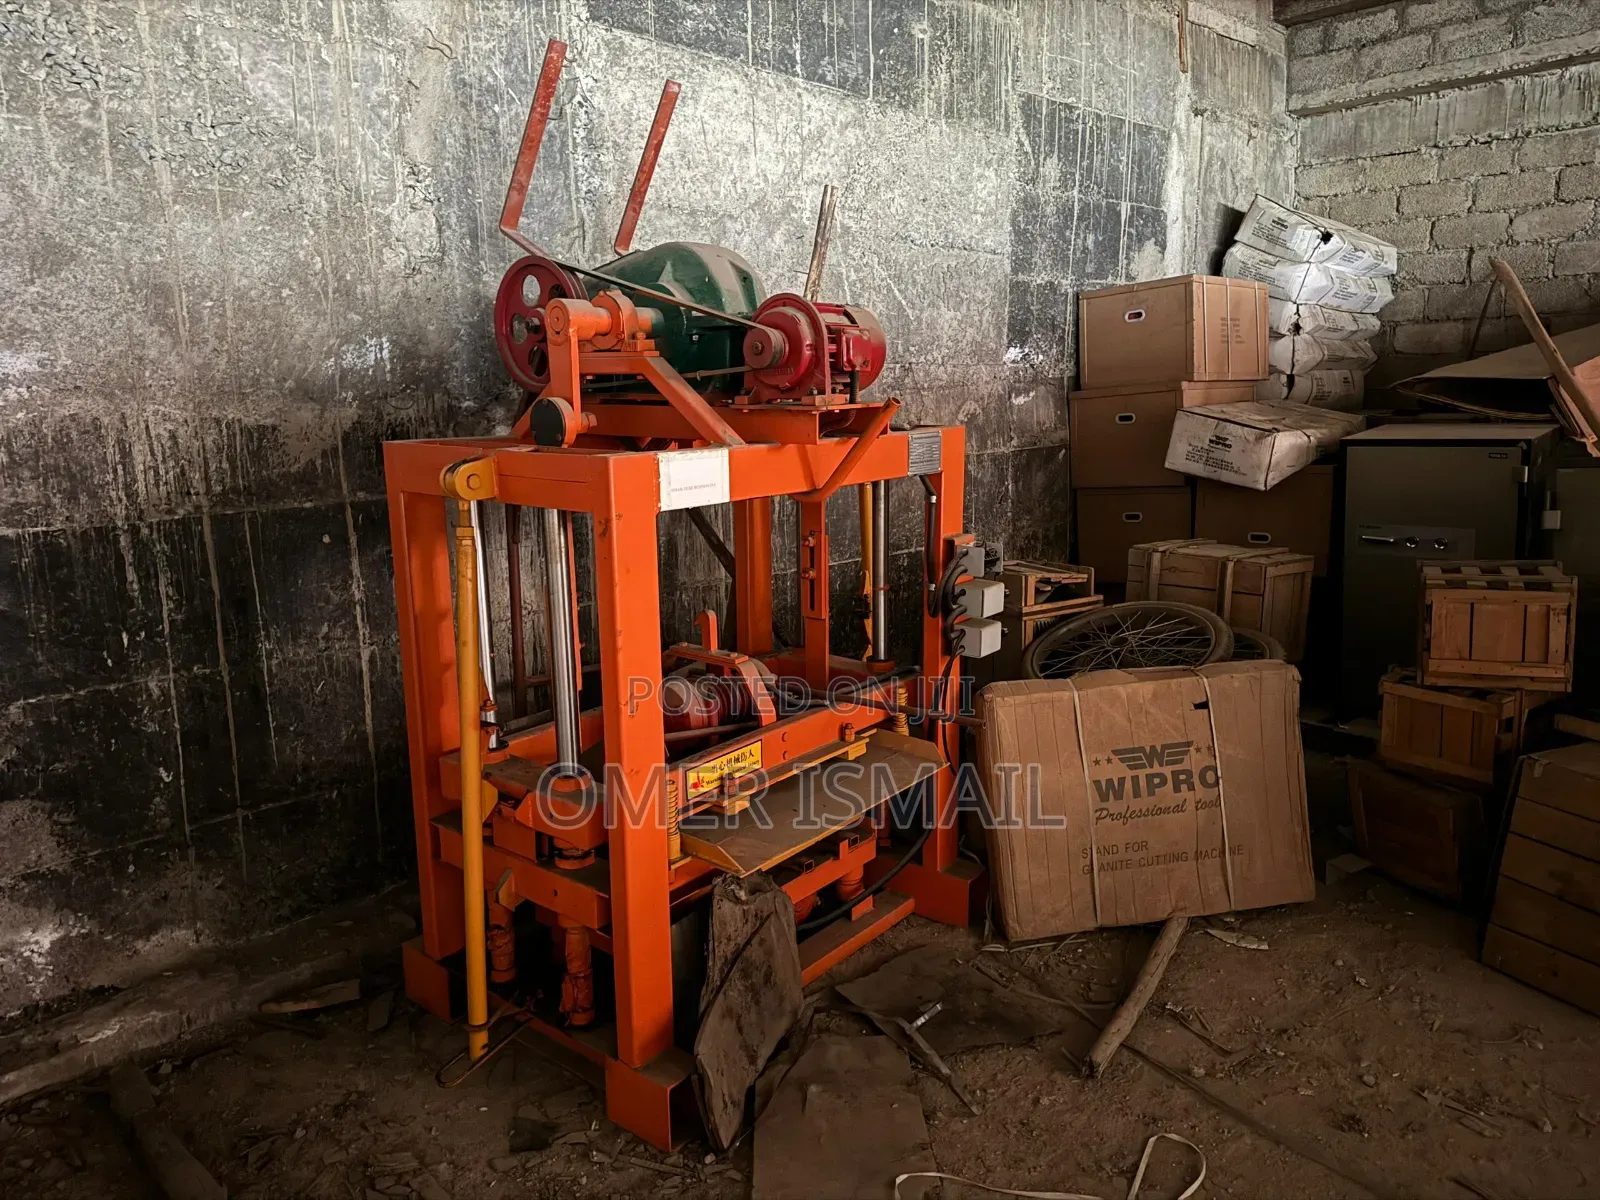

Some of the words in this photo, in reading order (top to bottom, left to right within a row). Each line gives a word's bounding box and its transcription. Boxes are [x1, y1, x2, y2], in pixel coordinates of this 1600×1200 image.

[1208, 438, 1233, 449] WIPRO
[1093, 765, 1220, 803] WIPRO
[1095, 798, 1188, 826] Professional
[1124, 840, 1149, 854] FOR
[1081, 859, 1133, 876] GANITE
[1138, 851, 1189, 868] CUTTING
